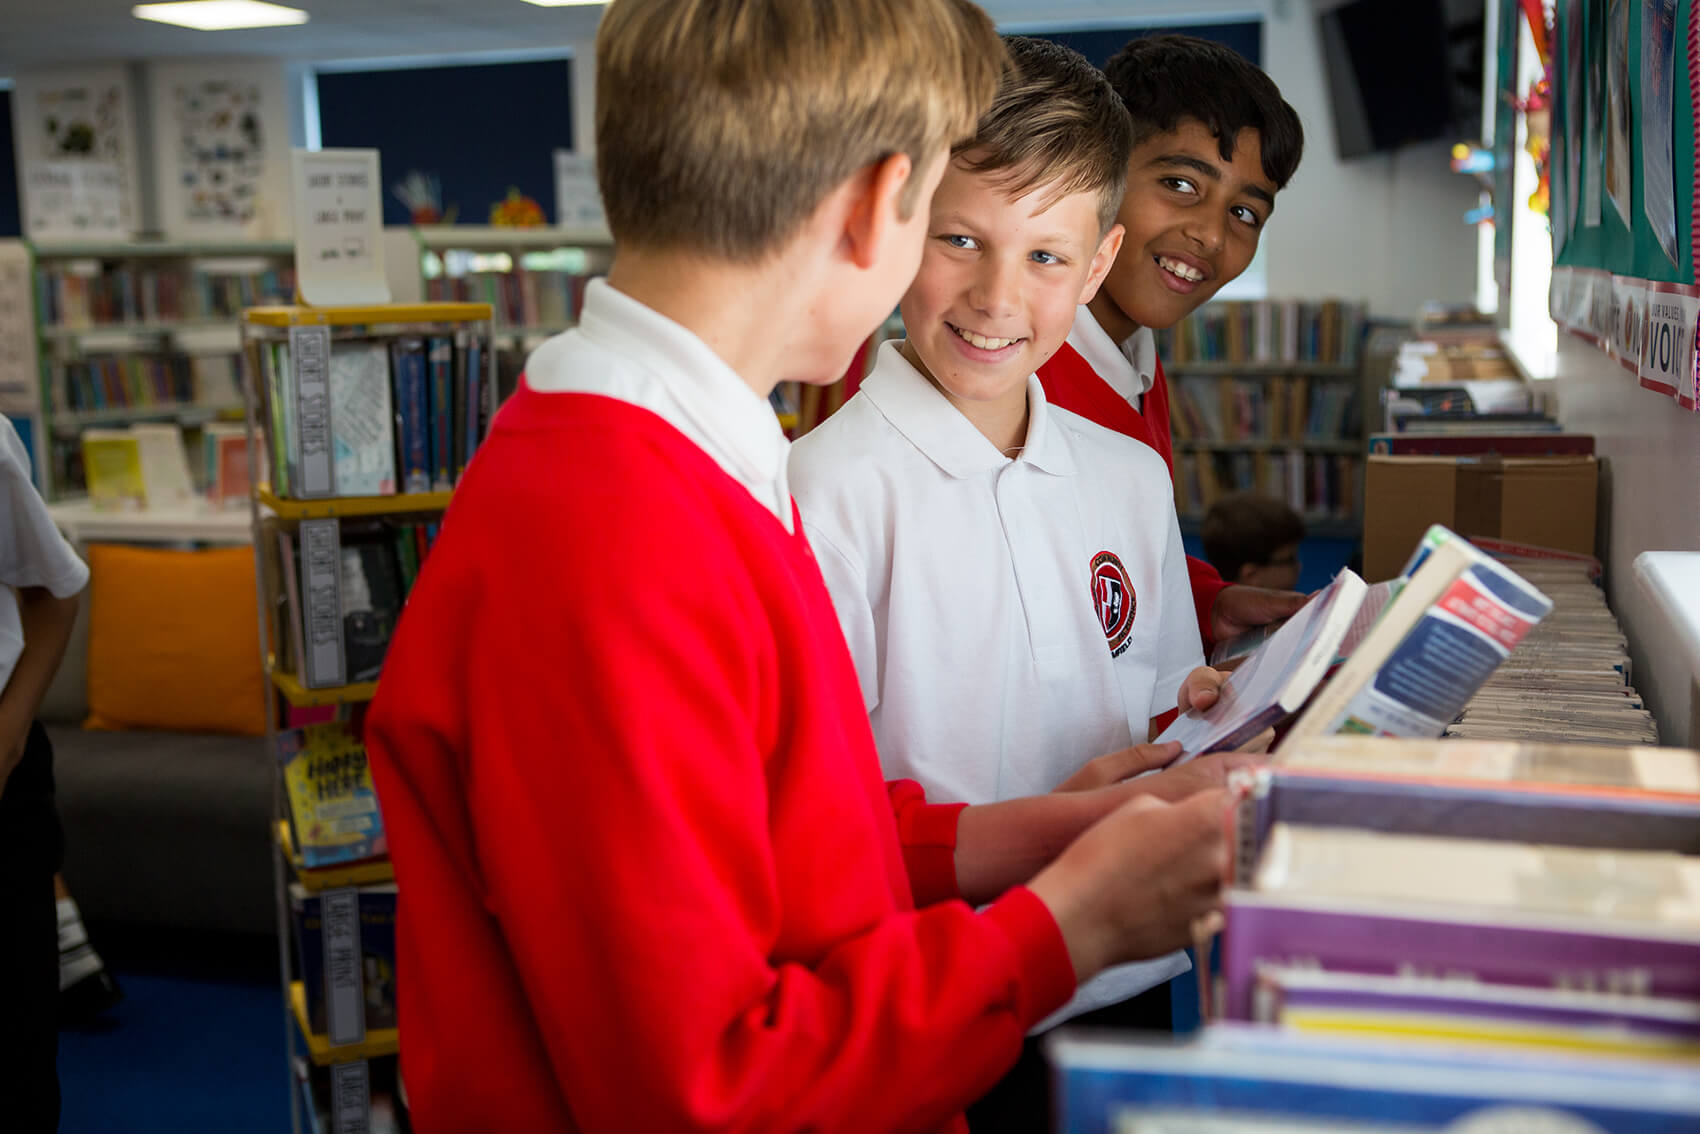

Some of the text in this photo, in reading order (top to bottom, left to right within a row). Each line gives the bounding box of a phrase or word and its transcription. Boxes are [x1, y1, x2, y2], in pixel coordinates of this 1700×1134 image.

[297, 334, 328, 456] SHORT STORIES
[309, 527, 338, 646] SHORT STORIES
[326, 894, 356, 989] LARGE PRINT
